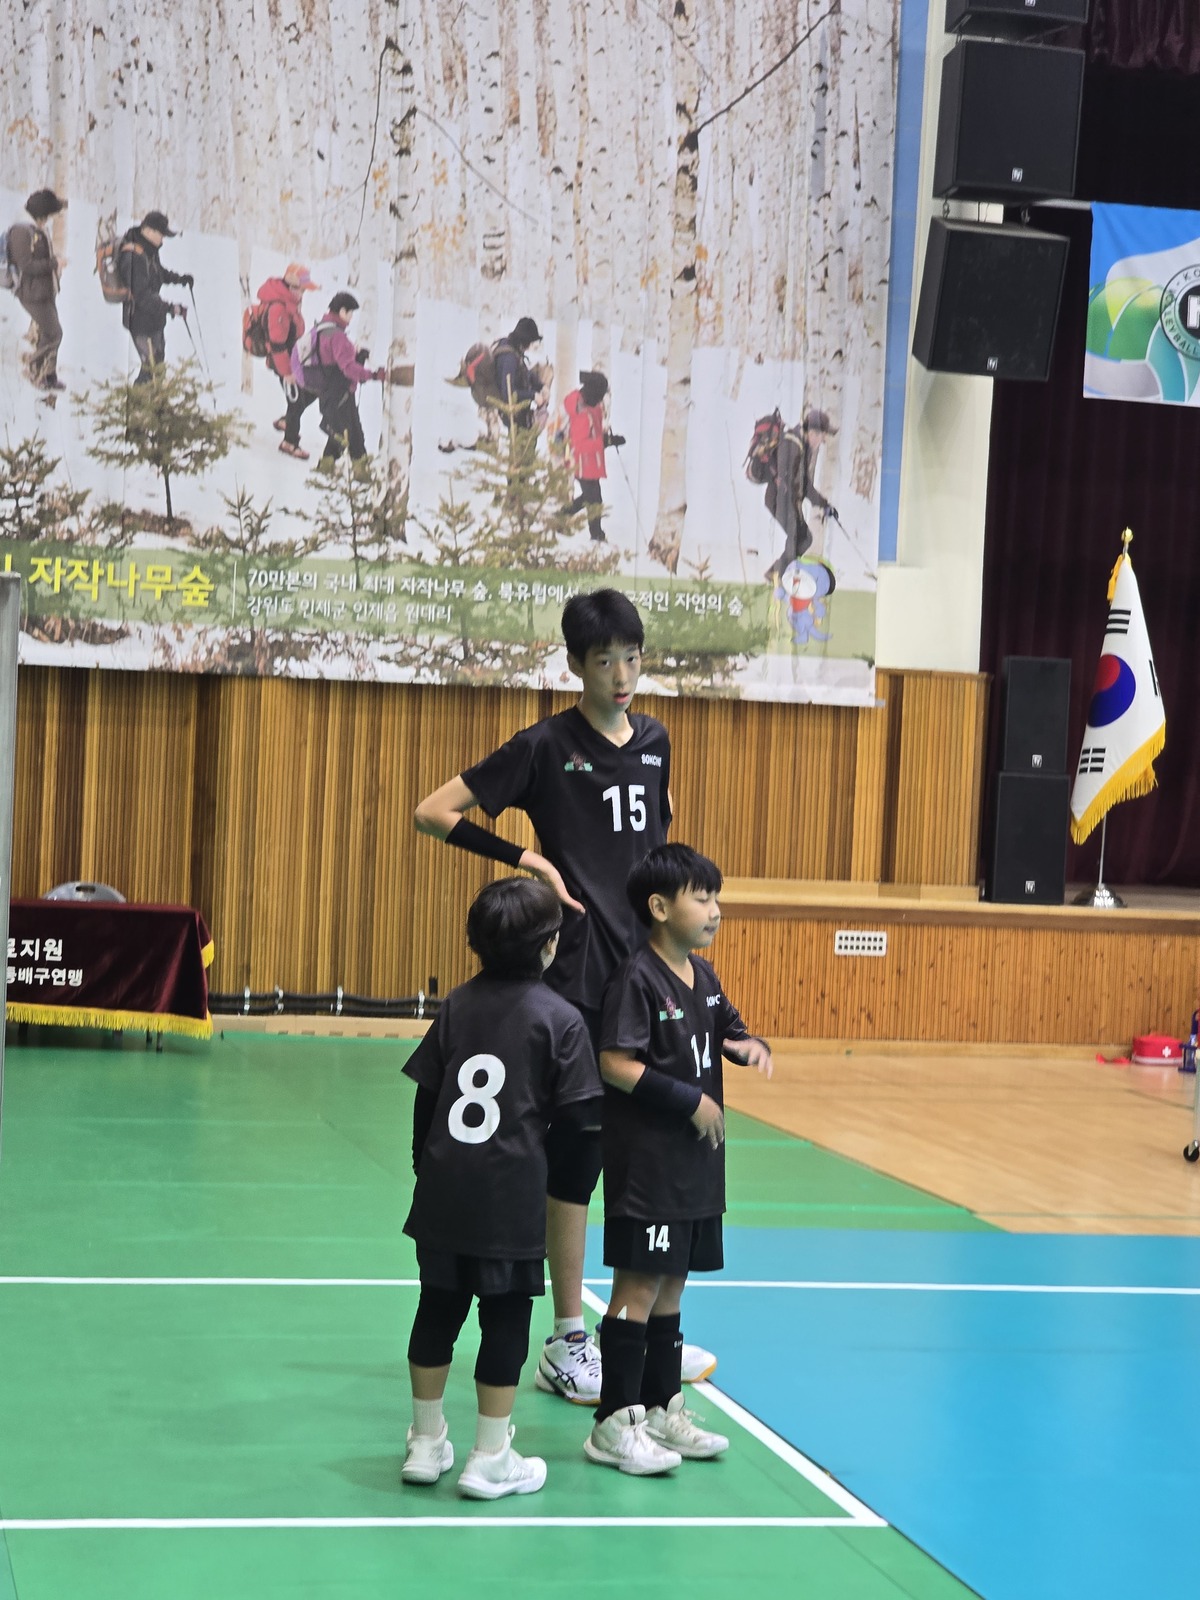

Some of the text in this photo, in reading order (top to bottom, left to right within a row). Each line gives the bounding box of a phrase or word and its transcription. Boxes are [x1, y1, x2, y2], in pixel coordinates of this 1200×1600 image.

[28, 556, 215, 607] 자작나무숲
[248, 567, 318, 592] 70만본의
[324, 572, 357, 594] 국내
[363, 575, 395, 595] 최대
[400, 575, 465, 599] 자작나무
[472, 580, 492, 602] 숲,
[499, 581, 579, 606] 북유럽에서
[619, 589, 669, 612] 국적인
[675, 593, 722, 615] 자연의
[728, 596, 744, 617] 숲
[247, 595, 451, 624] 강원도 인제군 인제읍 원대리
[602, 784, 647, 832] 15
[690, 1031, 712, 1078] 14
[448, 1053, 506, 1145] 8
[646, 1224, 671, 1252] 14
